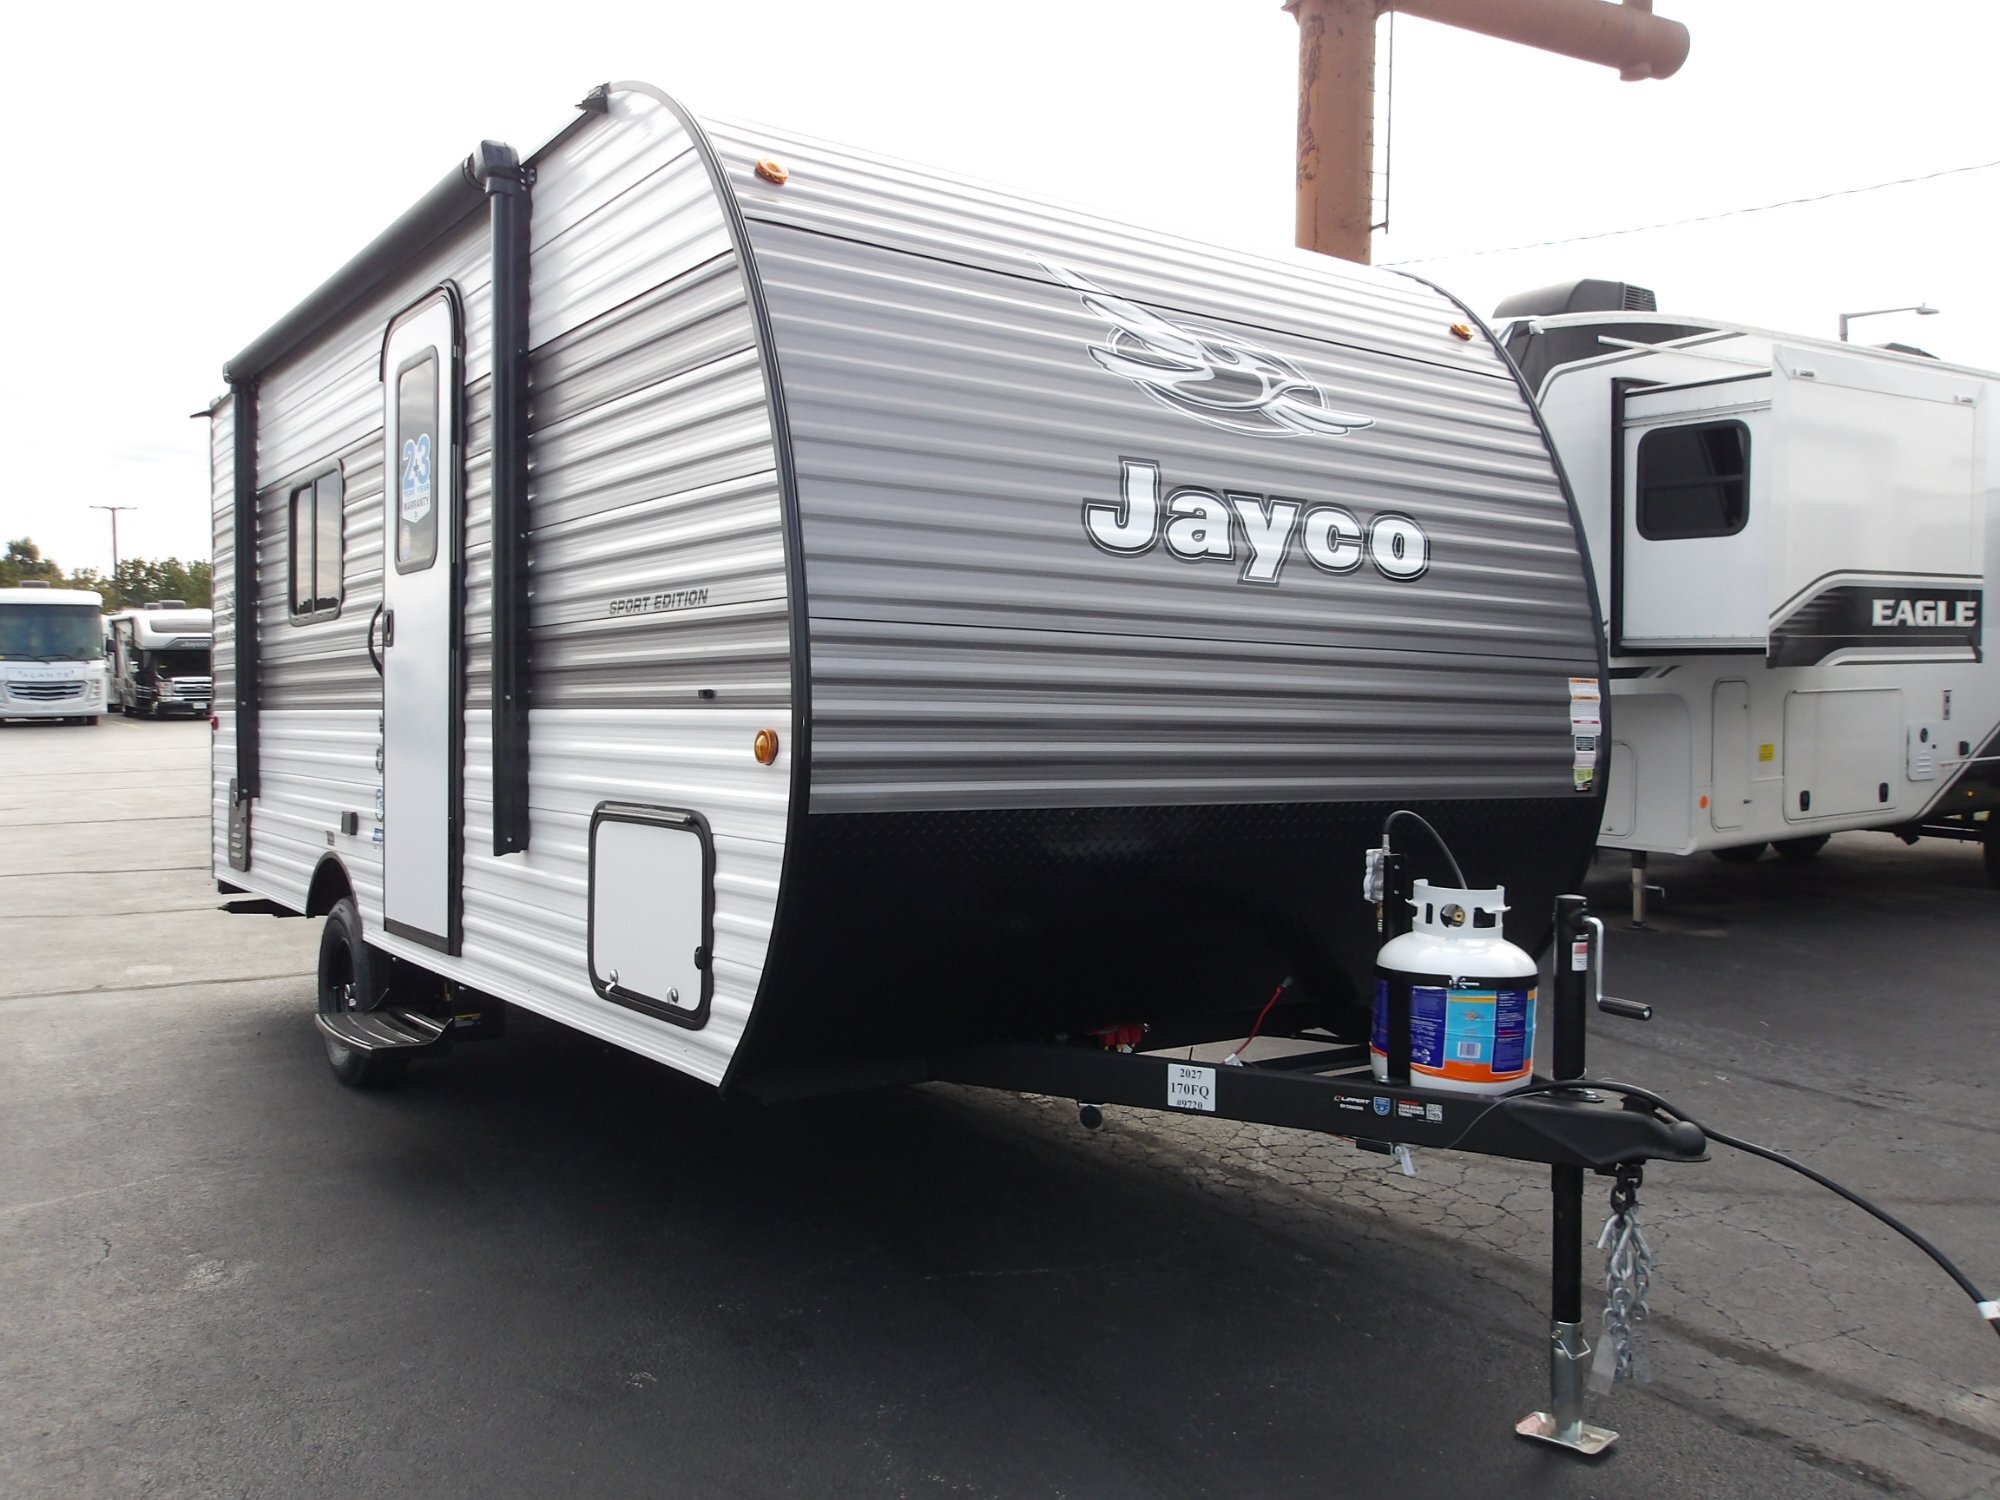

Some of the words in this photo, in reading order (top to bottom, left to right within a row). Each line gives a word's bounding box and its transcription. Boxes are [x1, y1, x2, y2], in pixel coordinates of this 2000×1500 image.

[1082, 455, 1431, 587] Jayco
[609, 596, 651, 615] SPORT
[654, 588, 709, 610] EDITION
[1871, 598, 1978, 627] EAGLE
[1180, 1068, 1203, 1080] 2027
[1171, 1082, 1210, 1100] 170FQ
